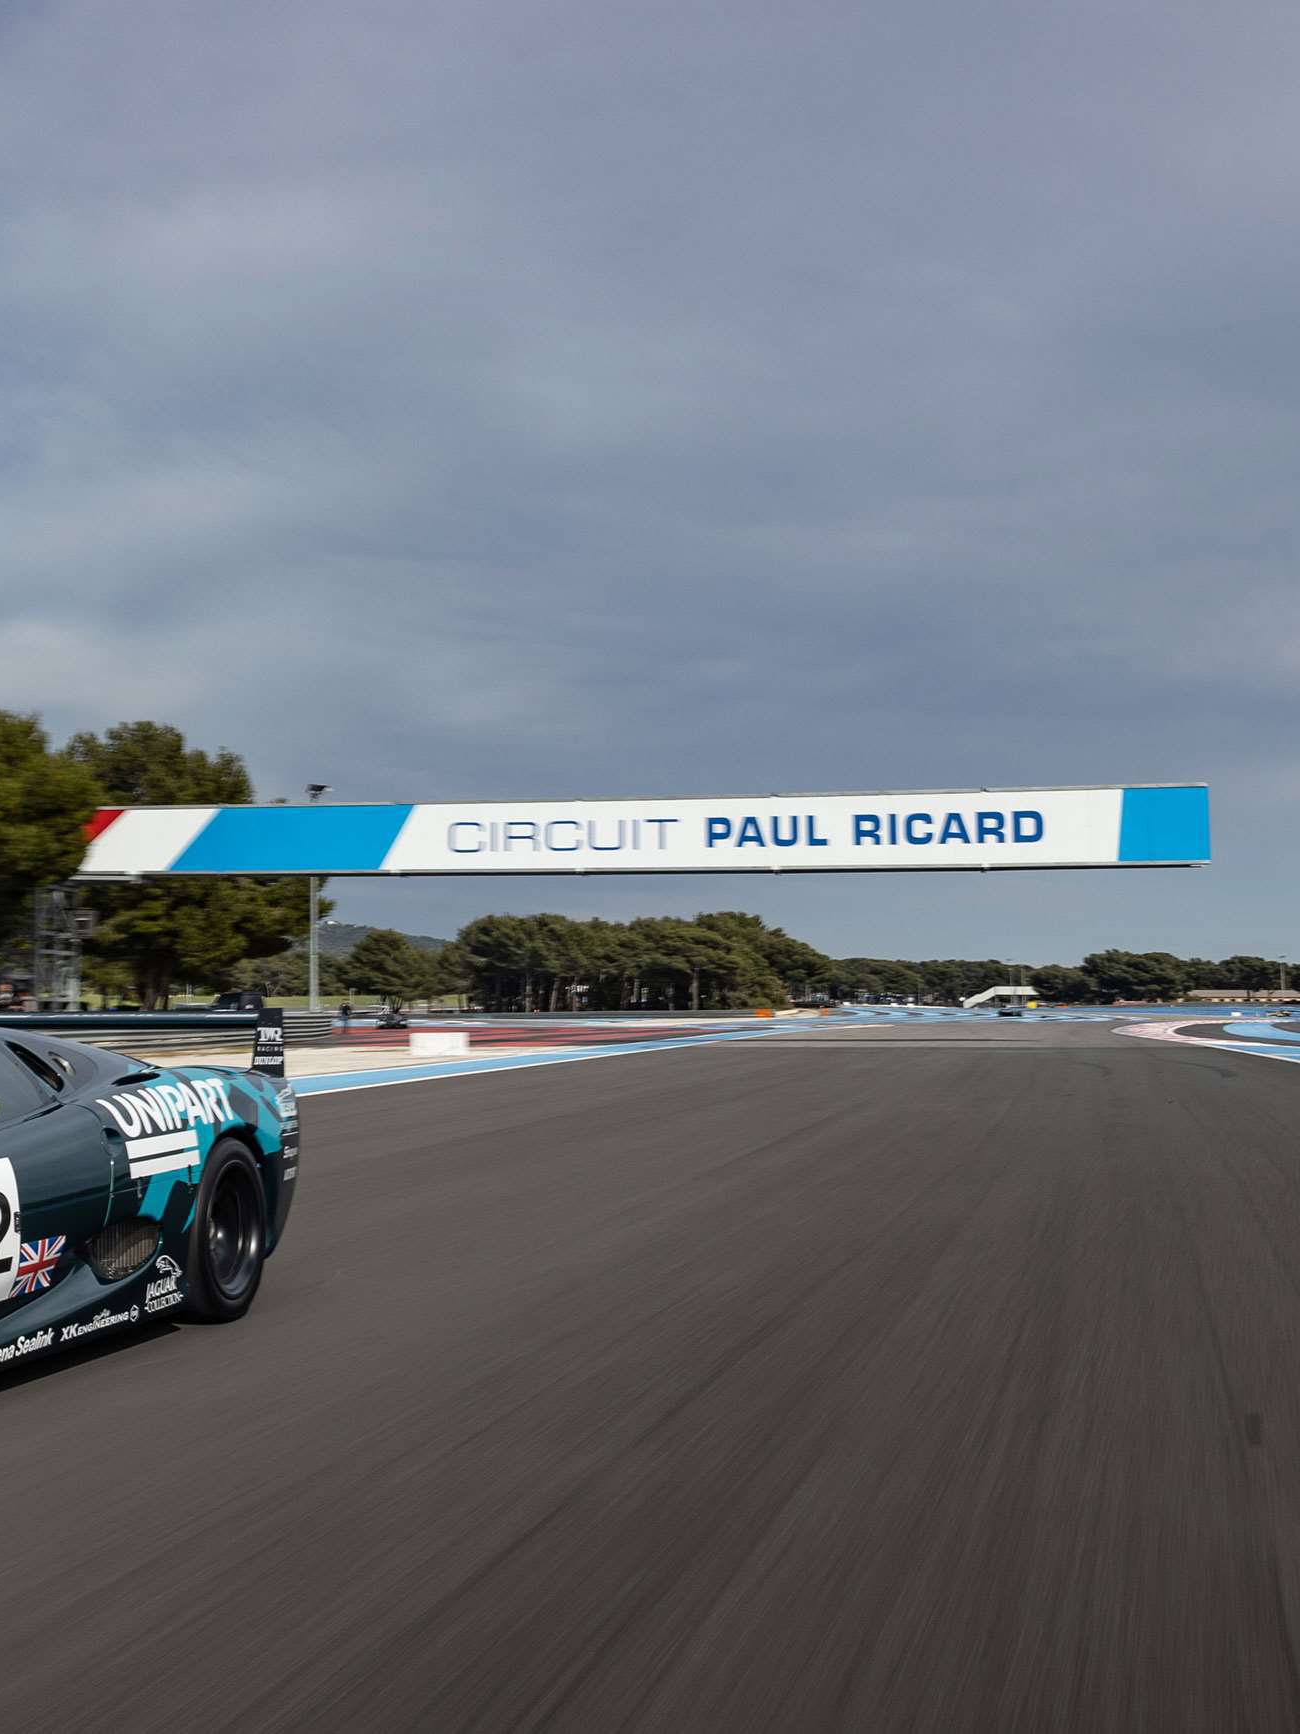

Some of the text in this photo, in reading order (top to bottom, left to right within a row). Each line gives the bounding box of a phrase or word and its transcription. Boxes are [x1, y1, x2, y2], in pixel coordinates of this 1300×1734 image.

[447, 810, 1044, 853] CIRCUIT PAUL RICARD
[257, 1027, 283, 1042] TWR
[253, 1056, 284, 1065] DUNLOP
[96, 1078, 234, 1138] UNIPART
[145, 1275, 178, 1304] JAGUAR
[15, 1326, 54, 1357] Sealink
